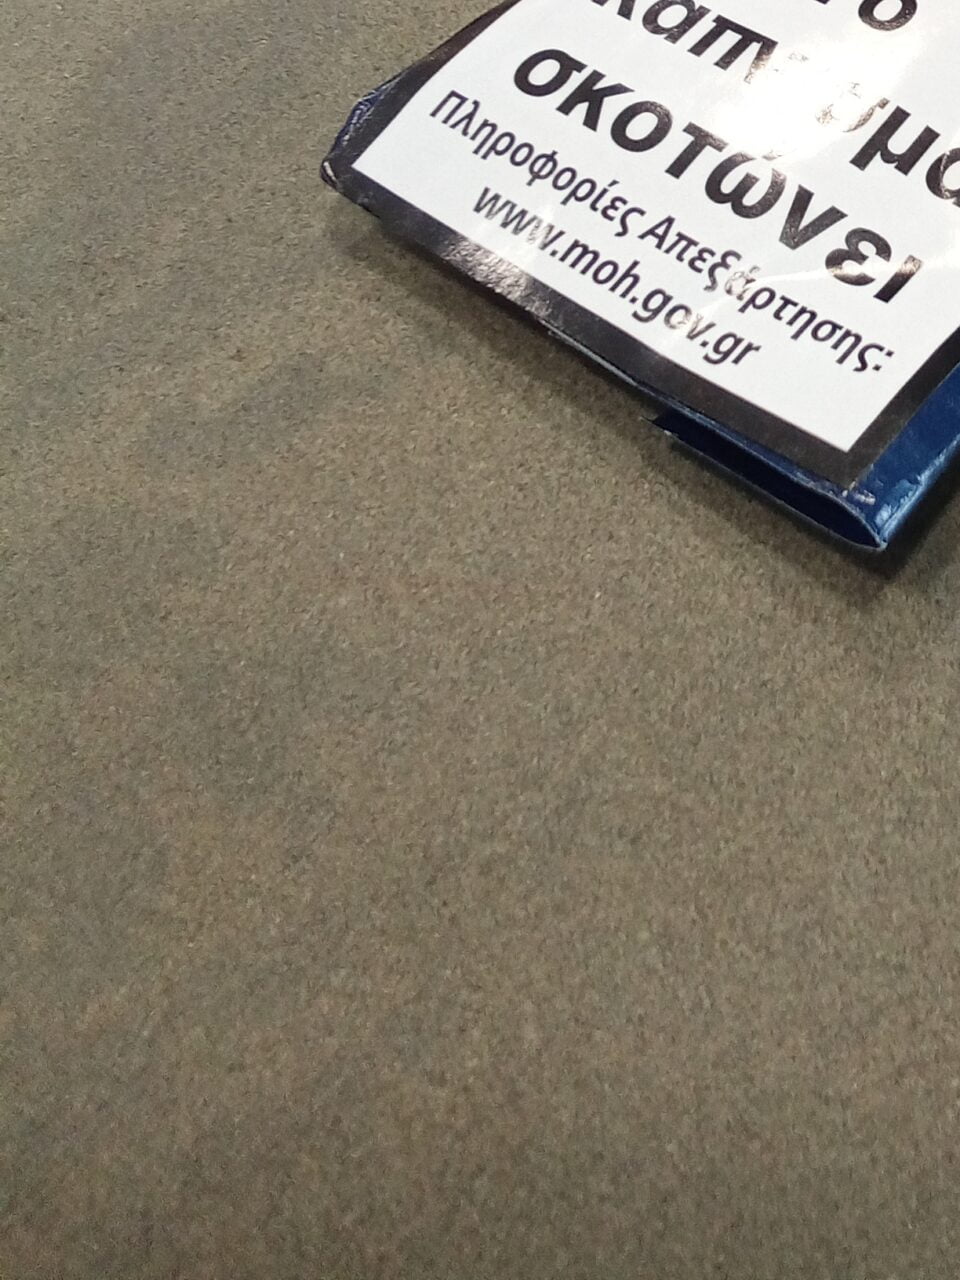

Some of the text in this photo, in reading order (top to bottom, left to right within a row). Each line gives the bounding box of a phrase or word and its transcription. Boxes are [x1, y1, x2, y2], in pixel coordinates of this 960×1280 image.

[429, 89, 646, 237] Πληροφορίες
[513, 48, 923, 304] σκοτώνει
[472, 186, 762, 367] www.moh.gov.gr
